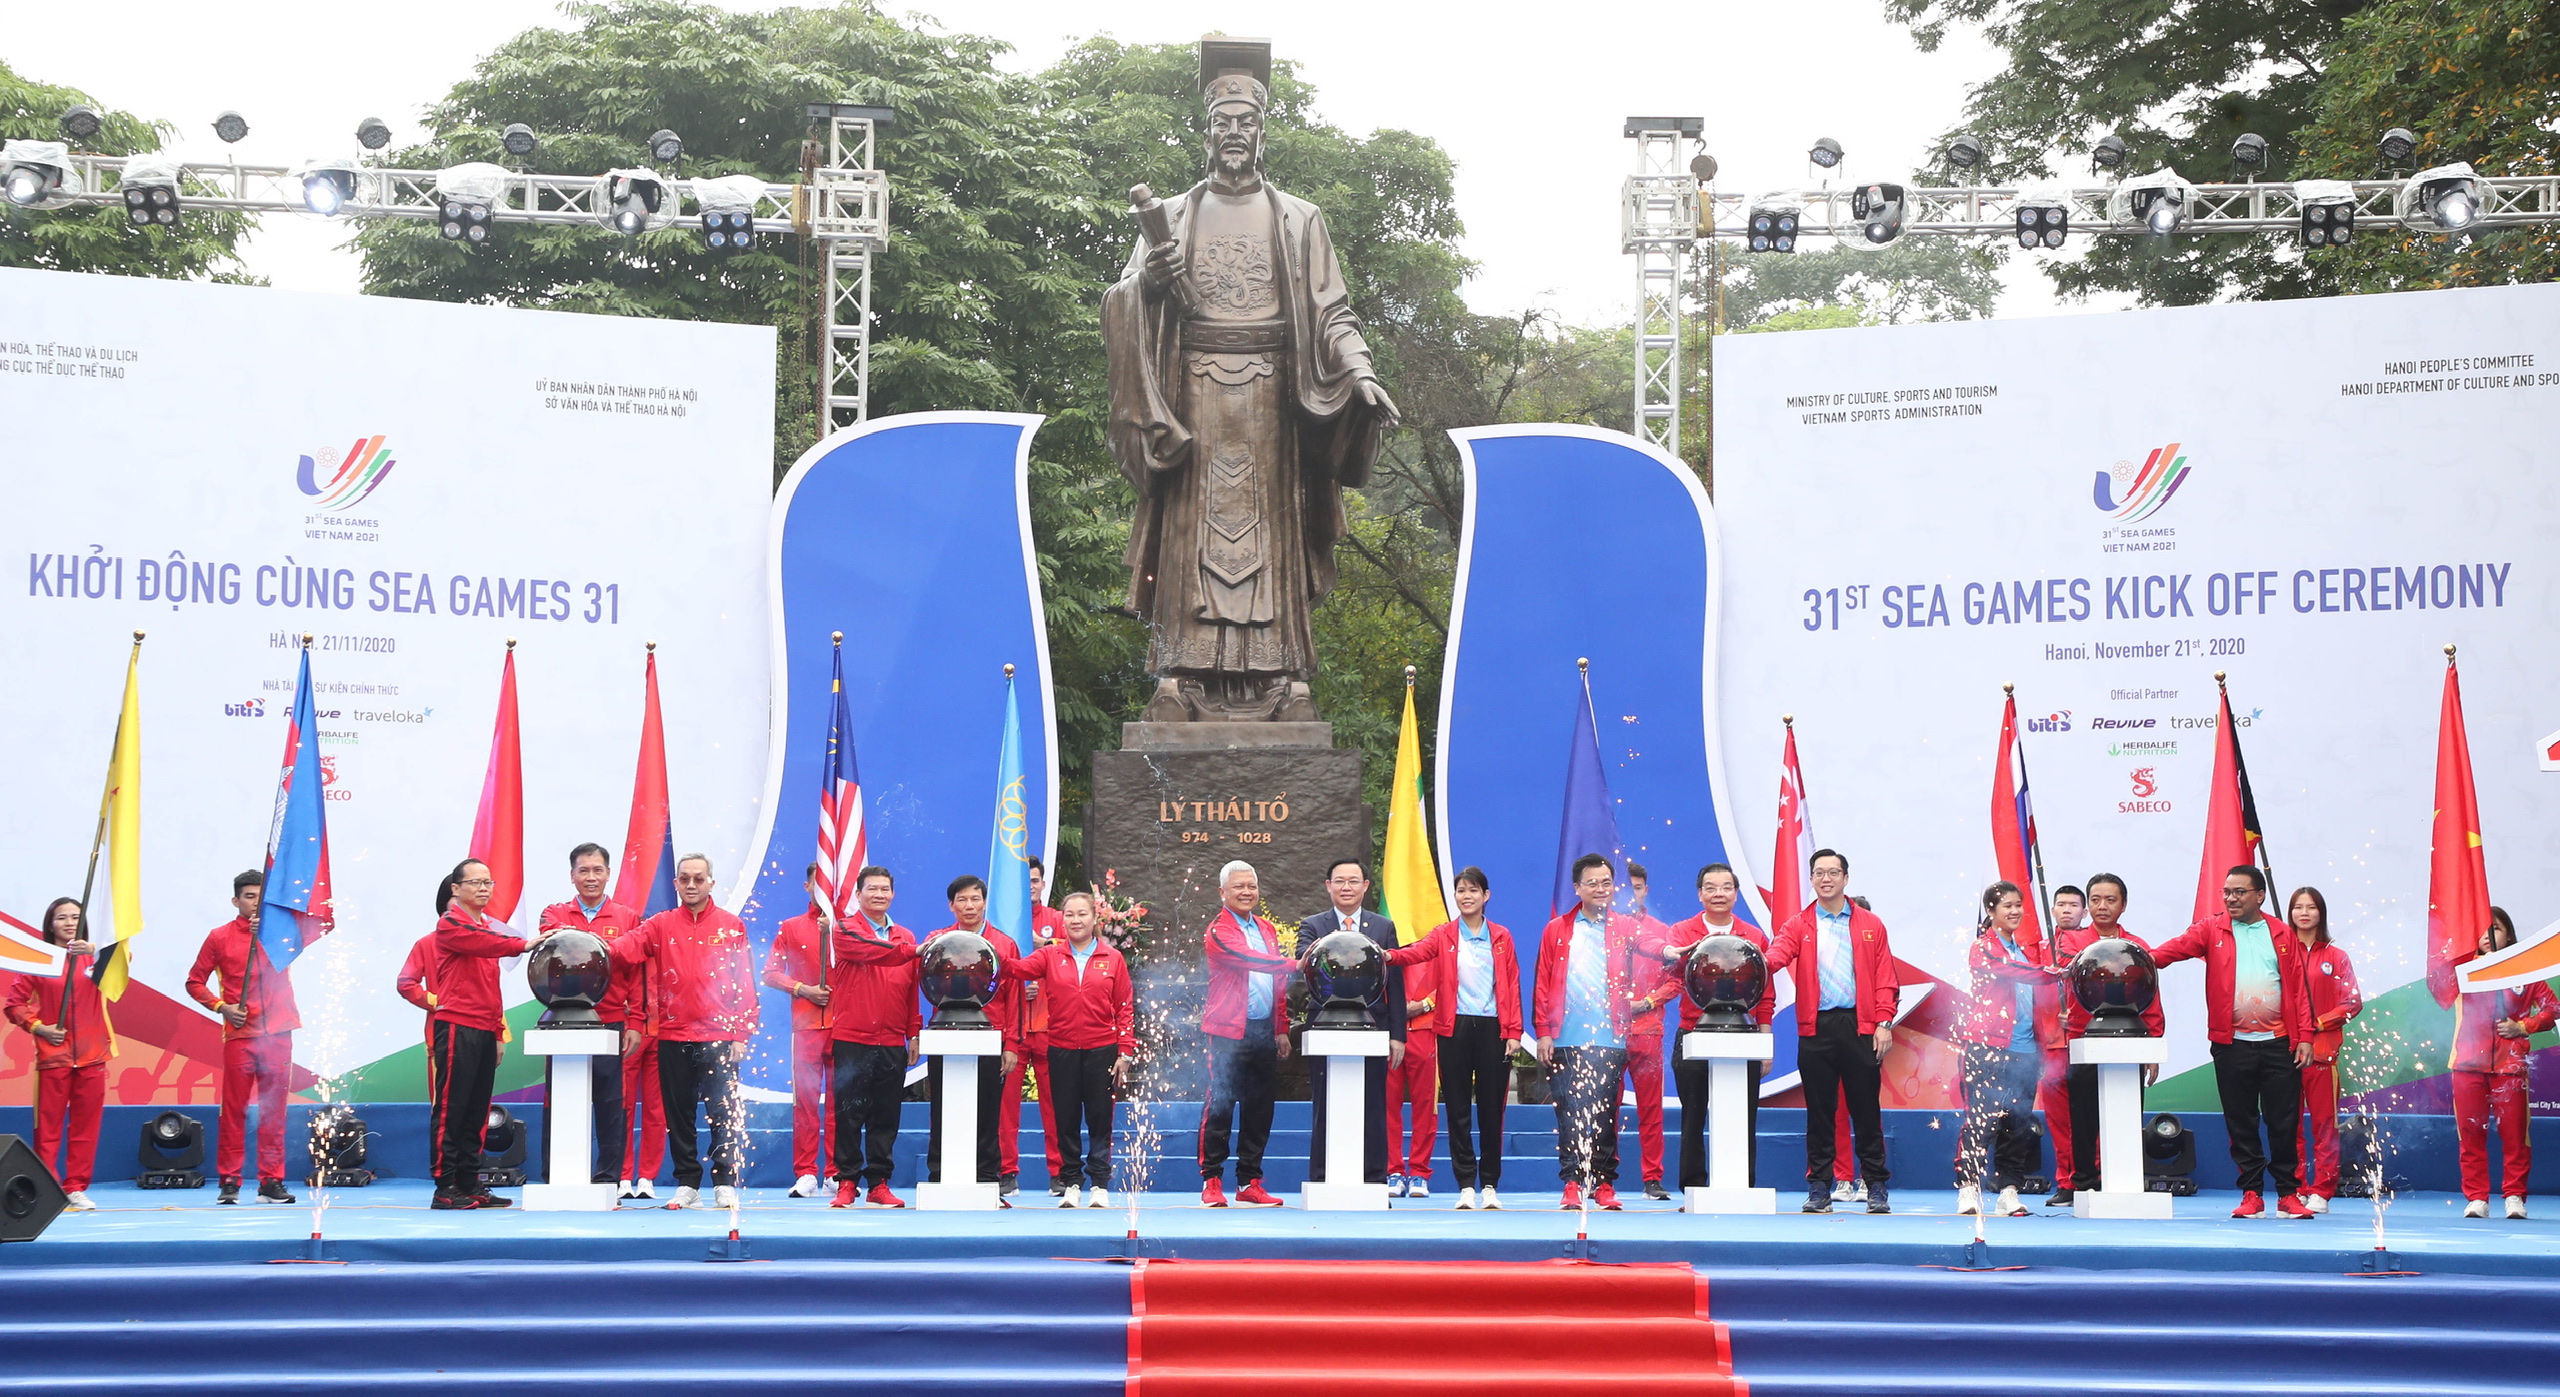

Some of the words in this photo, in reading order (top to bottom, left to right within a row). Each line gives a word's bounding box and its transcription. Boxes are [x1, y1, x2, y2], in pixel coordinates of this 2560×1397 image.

[57, 345, 82, 359] THAO
[85, 345, 97, 359] VÀ
[100, 348, 113, 360] DU
[117, 350, 138, 363] LỊCH
[13, 360, 33, 375] CỤC
[57, 363, 76, 377] DỤC
[99, 365, 125, 379] THAO
[2384, 361, 2417, 376] HANOI
[2420, 358, 2470, 373] PEOPLE'S
[2473, 354, 2534, 370] COMMITTEE
[550, 381, 568, 393] BAN
[570, 381, 595, 394] NHÂN
[597, 383, 615, 396] DÂN
[617, 384, 646, 398] THÀNH
[669, 387, 681, 401] HÀ
[683, 388, 698, 404] NỘI
[2341, 383, 2373, 396] HANOI
[2376, 378, 2444, 395] DEPARTMENT
[2447, 378, 2461, 391] OF
[2463, 375, 2510, 390] CULTURE
[2513, 374, 2535, 388] AND
[2538, 372, 2560, 386] SPO
[1786, 394, 1831, 408] MINISTRY
[1833, 393, 1845, 406] OF
[1847, 391, 1891, 405] CULTURE,
[1893, 388, 1930, 402] SPORTS
[1932, 387, 1952, 400] AND
[1955, 385, 1998, 400] TOURISM
[581, 398, 599, 412] HÓA
[601, 399, 612, 413] VÀ
[633, 403, 655, 416] THAO
[657, 402, 669, 416] HÀ
[671, 404, 686, 419] NỘI
[1802, 411, 1847, 425] VIETNAM
[1850, 409, 1890, 423] SPORTS
[1894, 403, 1983, 421] ADMINISTRATION
[323, 517, 343, 526] SEA
[345, 518, 379, 528] GAMES
[305, 530, 327, 539] VIET
[329, 531, 353, 541] NAM
[356, 533, 379, 542] 2021
[2120, 529, 2139, 538] SEA
[2141, 528, 2175, 538] GAMES
[2103, 543, 2125, 553] VIET
[2126, 542, 2150, 552] NAM
[2152, 541, 2176, 551] 2021
[29, 543, 123, 600] KHỞI
[136, 549, 241, 612] ĐỘNG
[256, 555, 354, 610] CÙNG
[368, 570, 436, 615] SEA
[449, 575, 571, 622] GAMES
[583, 582, 619, 624] 31
[1803, 584, 1871, 632] 31ST
[1882, 583, 1951, 629] SEA
[1963, 578, 2091, 625] GAMES
[2105, 575, 2194, 620] KICK
[2207, 571, 2278, 616] OFF
[2292, 562, 2512, 614] CEREMONY
[269, 629, 288, 649] HÀ
[323, 635, 396, 653] 21/11/2020
[2045, 642, 2090, 661] Hanoi,
[2095, 640, 2170, 659] November
[2209, 637, 2246, 656] 2020
[262, 678, 280, 691] NHÀ
[282, 679, 294, 692] TÀI
[329, 681, 348, 695] KIỆN
[350, 682, 375, 695] CHÍNH
[2110, 688, 2143, 701] Official
[2145, 688, 2179, 700] Partner
[354, 708, 424, 724] traveloka
[2091, 717, 2157, 729] Revive
[2170, 713, 2252, 729] travelka
[2122, 741, 2178, 749] HERBALIFE
[2122, 748, 2178, 756] NUTRITION
[1160, 795, 1187, 823] LÝ
[1191, 795, 1250, 822] THÁI
[1255, 791, 1290, 823] TỔ
[2118, 800, 2171, 813] SABECO
[1181, 831, 1210, 843] 974
[1237, 831, 1272, 844] 1028
[2540, 1101, 2551, 1111] City
